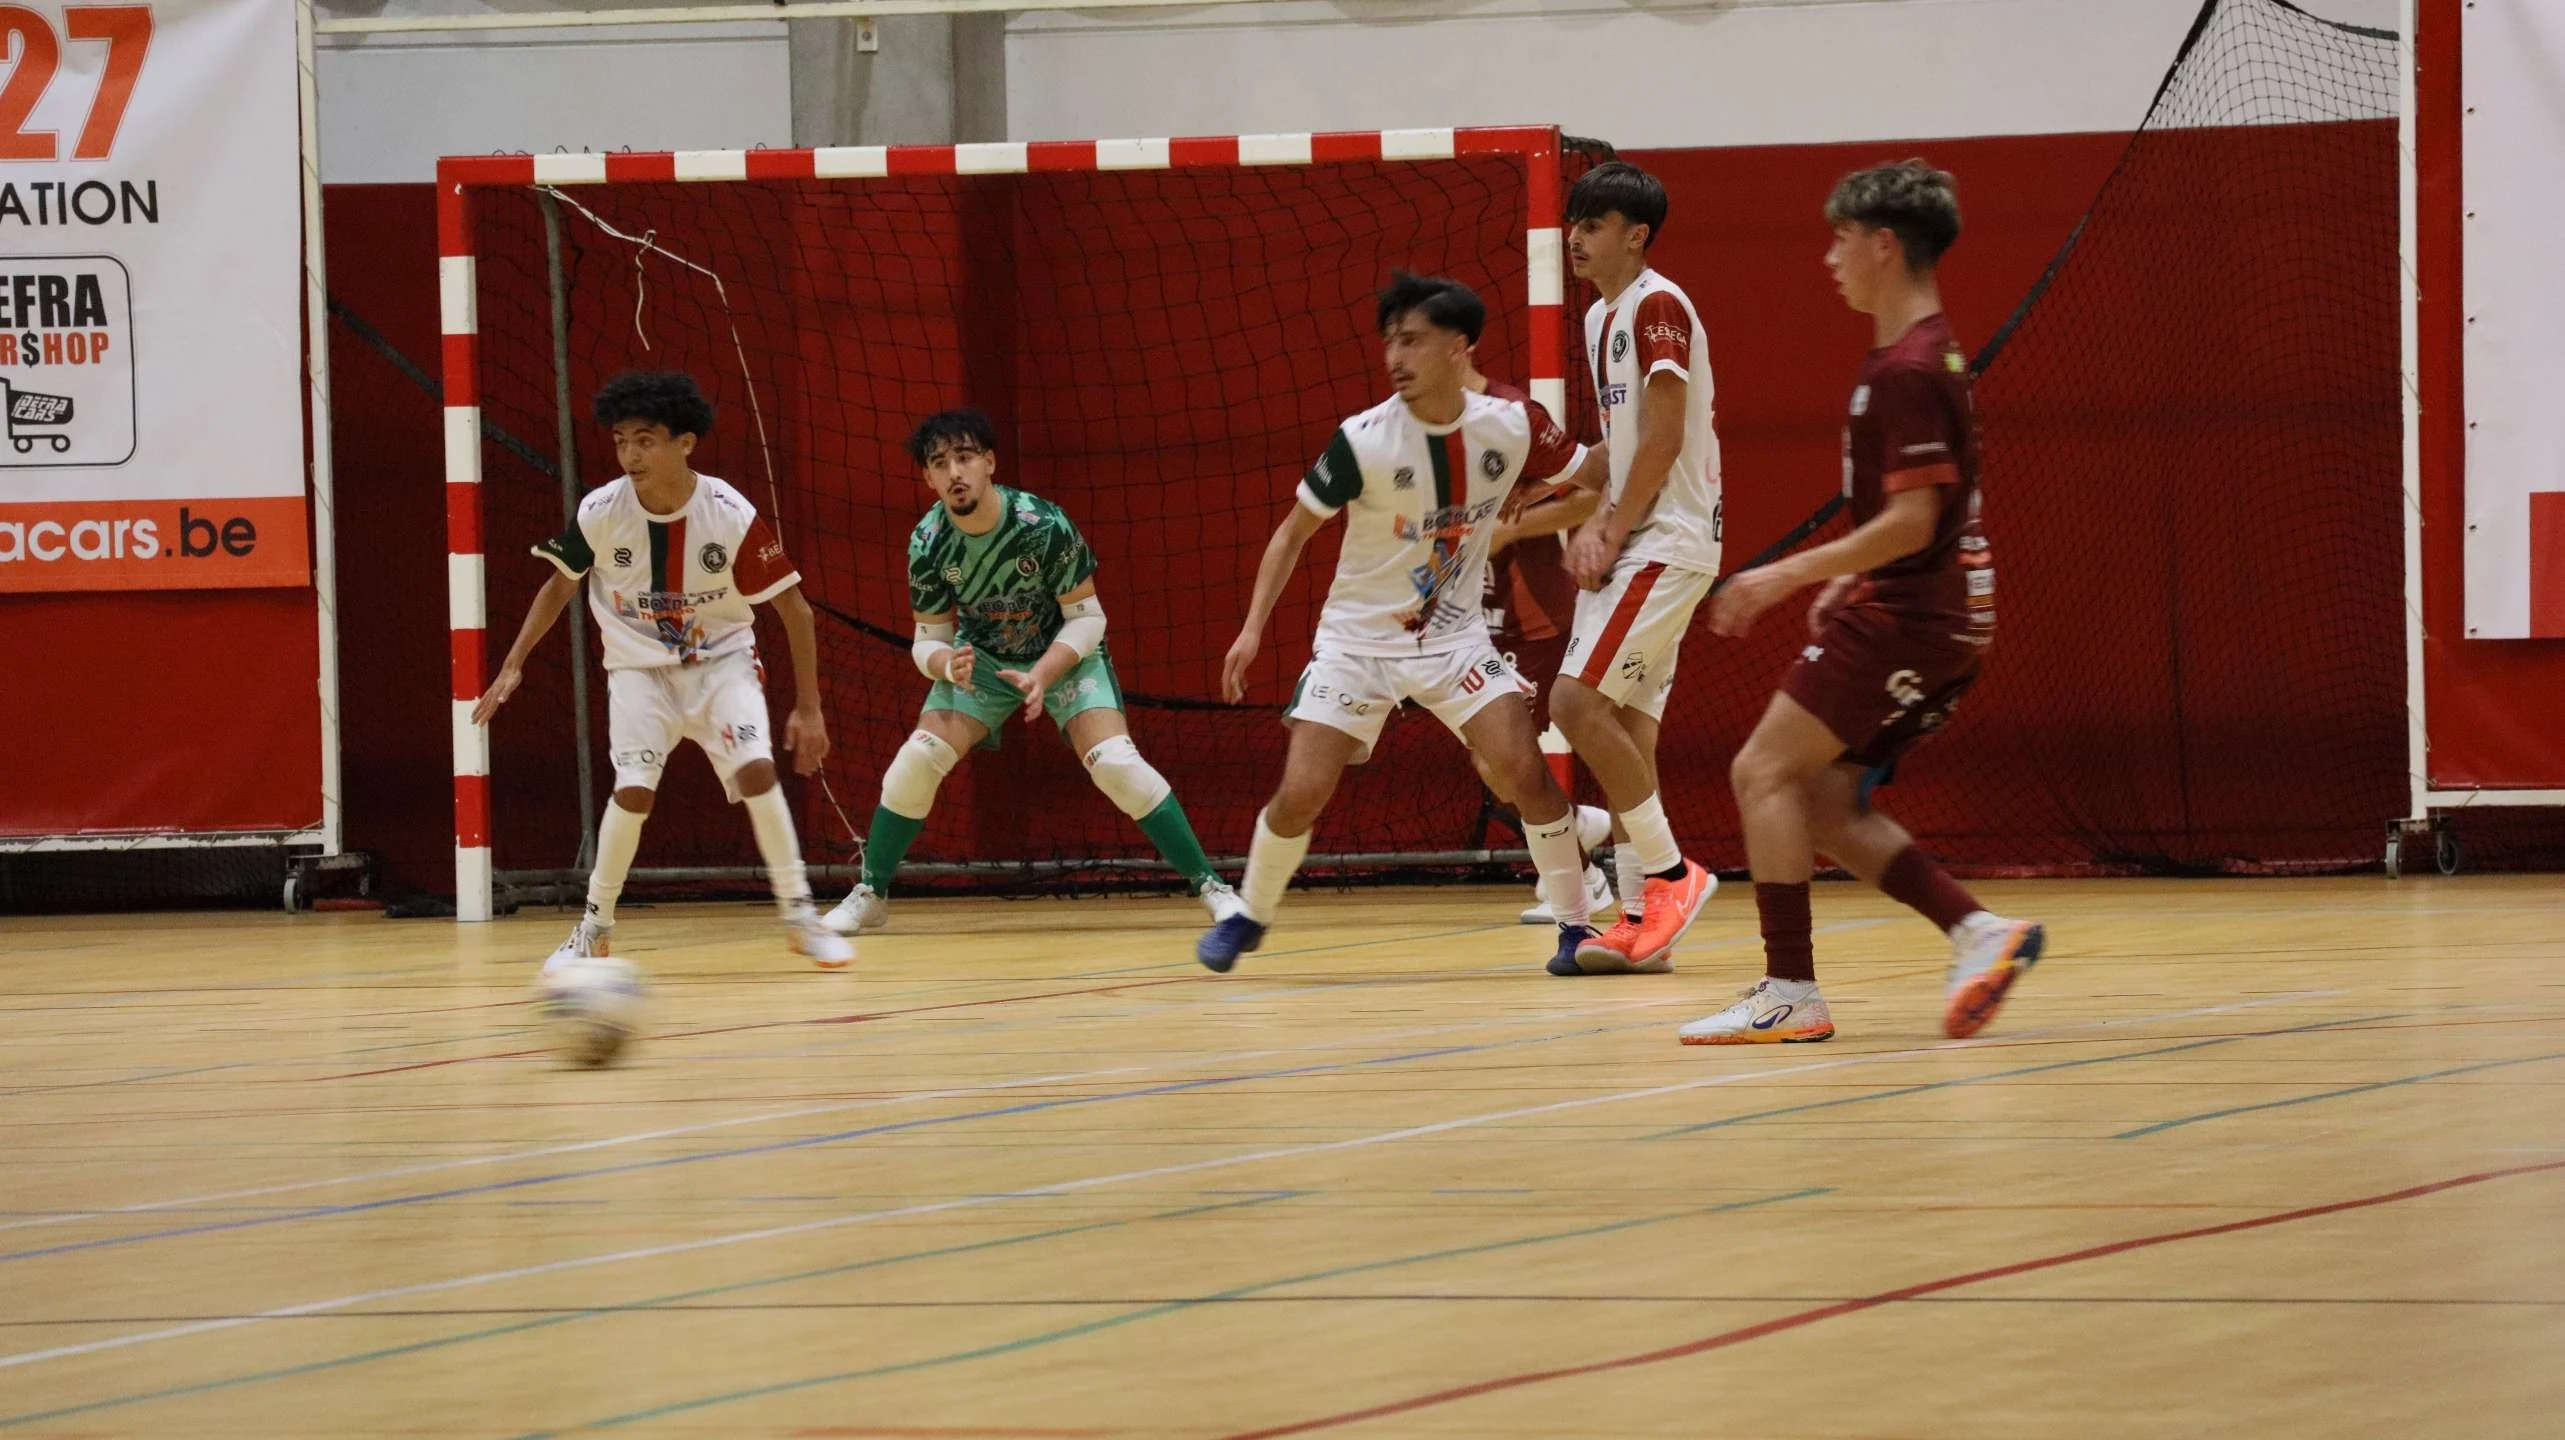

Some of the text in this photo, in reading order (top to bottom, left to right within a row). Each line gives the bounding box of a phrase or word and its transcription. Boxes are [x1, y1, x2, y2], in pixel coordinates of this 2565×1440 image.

[0, 4, 154, 160] 27
[0, 180, 159, 226] ATION
[0, 507, 257, 562] acars.be
